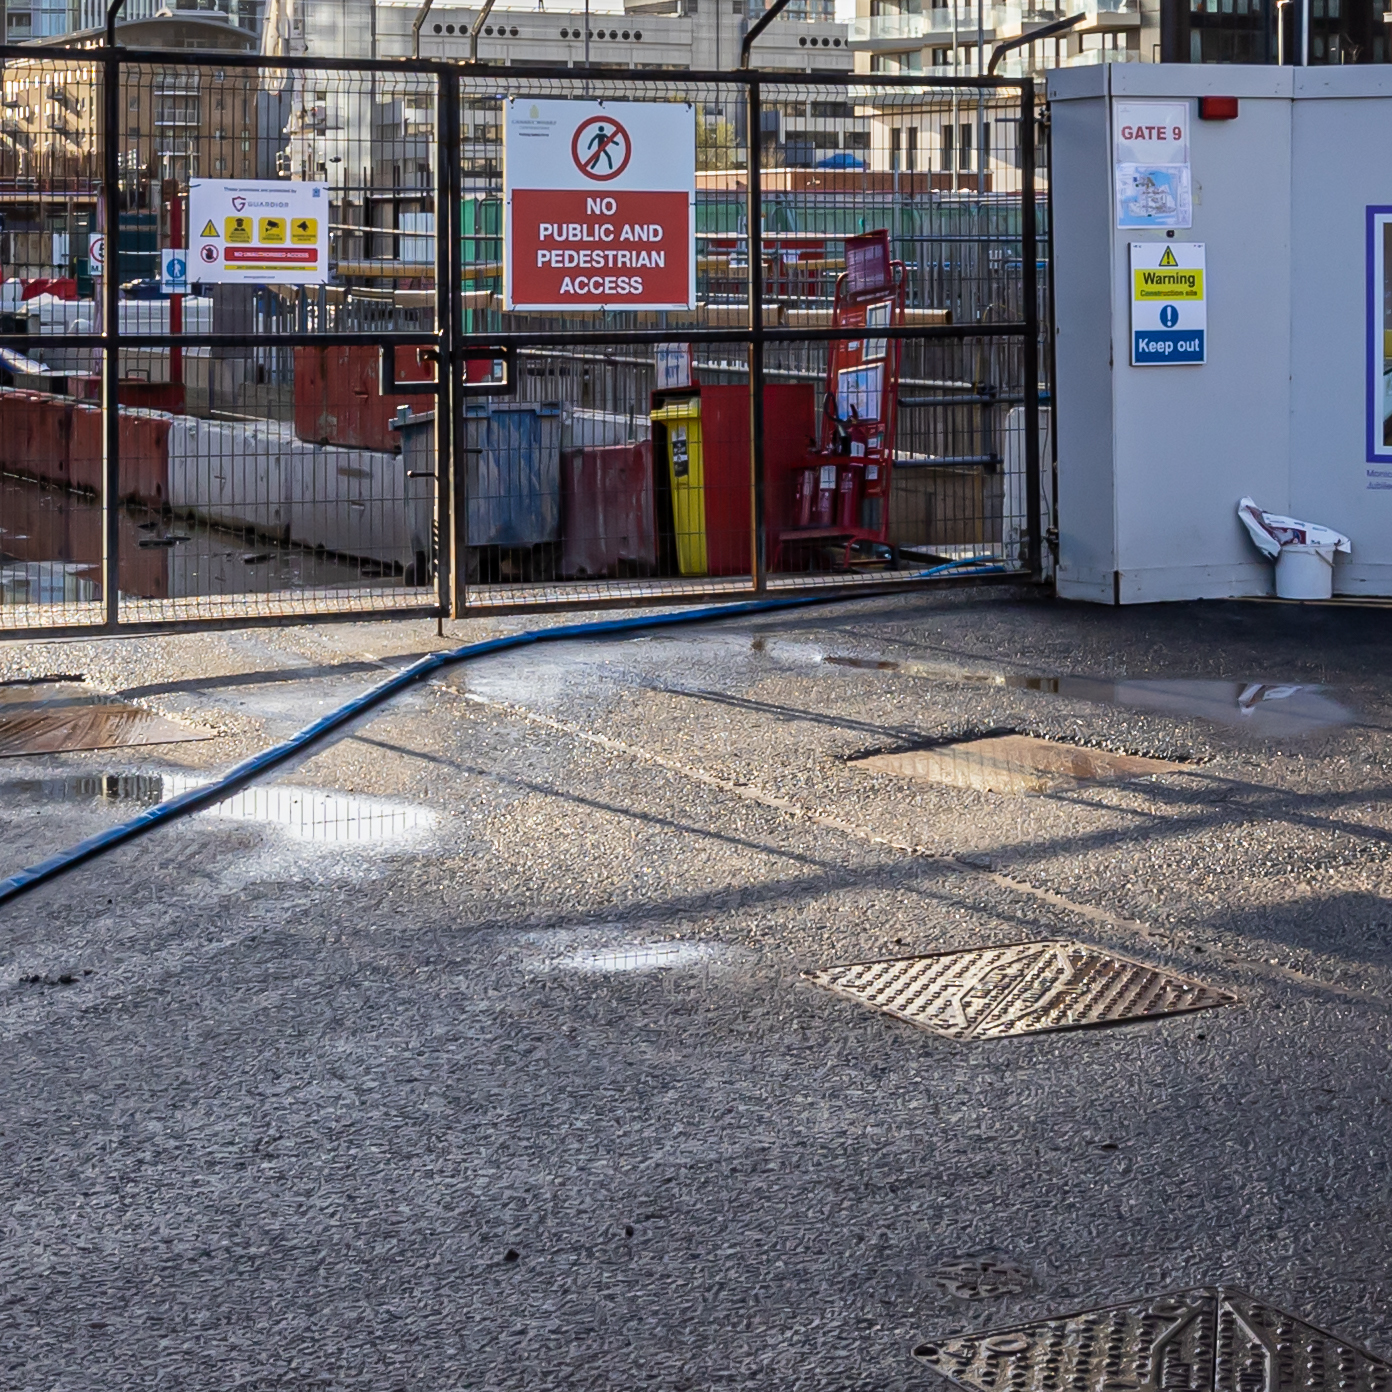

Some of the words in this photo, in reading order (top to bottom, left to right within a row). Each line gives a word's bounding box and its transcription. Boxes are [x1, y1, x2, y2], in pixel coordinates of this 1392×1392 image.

[1121, 125, 1167, 140] GATE
[1172, 126, 1182, 140] 9
[586, 197, 617, 215] NO
[539, 223, 615, 242] PUBLIC
[619, 224, 664, 242] AND
[536, 249, 665, 268] PEDESTRIAN
[559, 276, 644, 294] ACCESS
[1143, 272, 1196, 288] Warning
[1140, 289, 1184, 297] Construction
[1185, 289, 1197, 297] site
[1138, 338, 1174, 356] Keep
[1177, 338, 1200, 352] out
